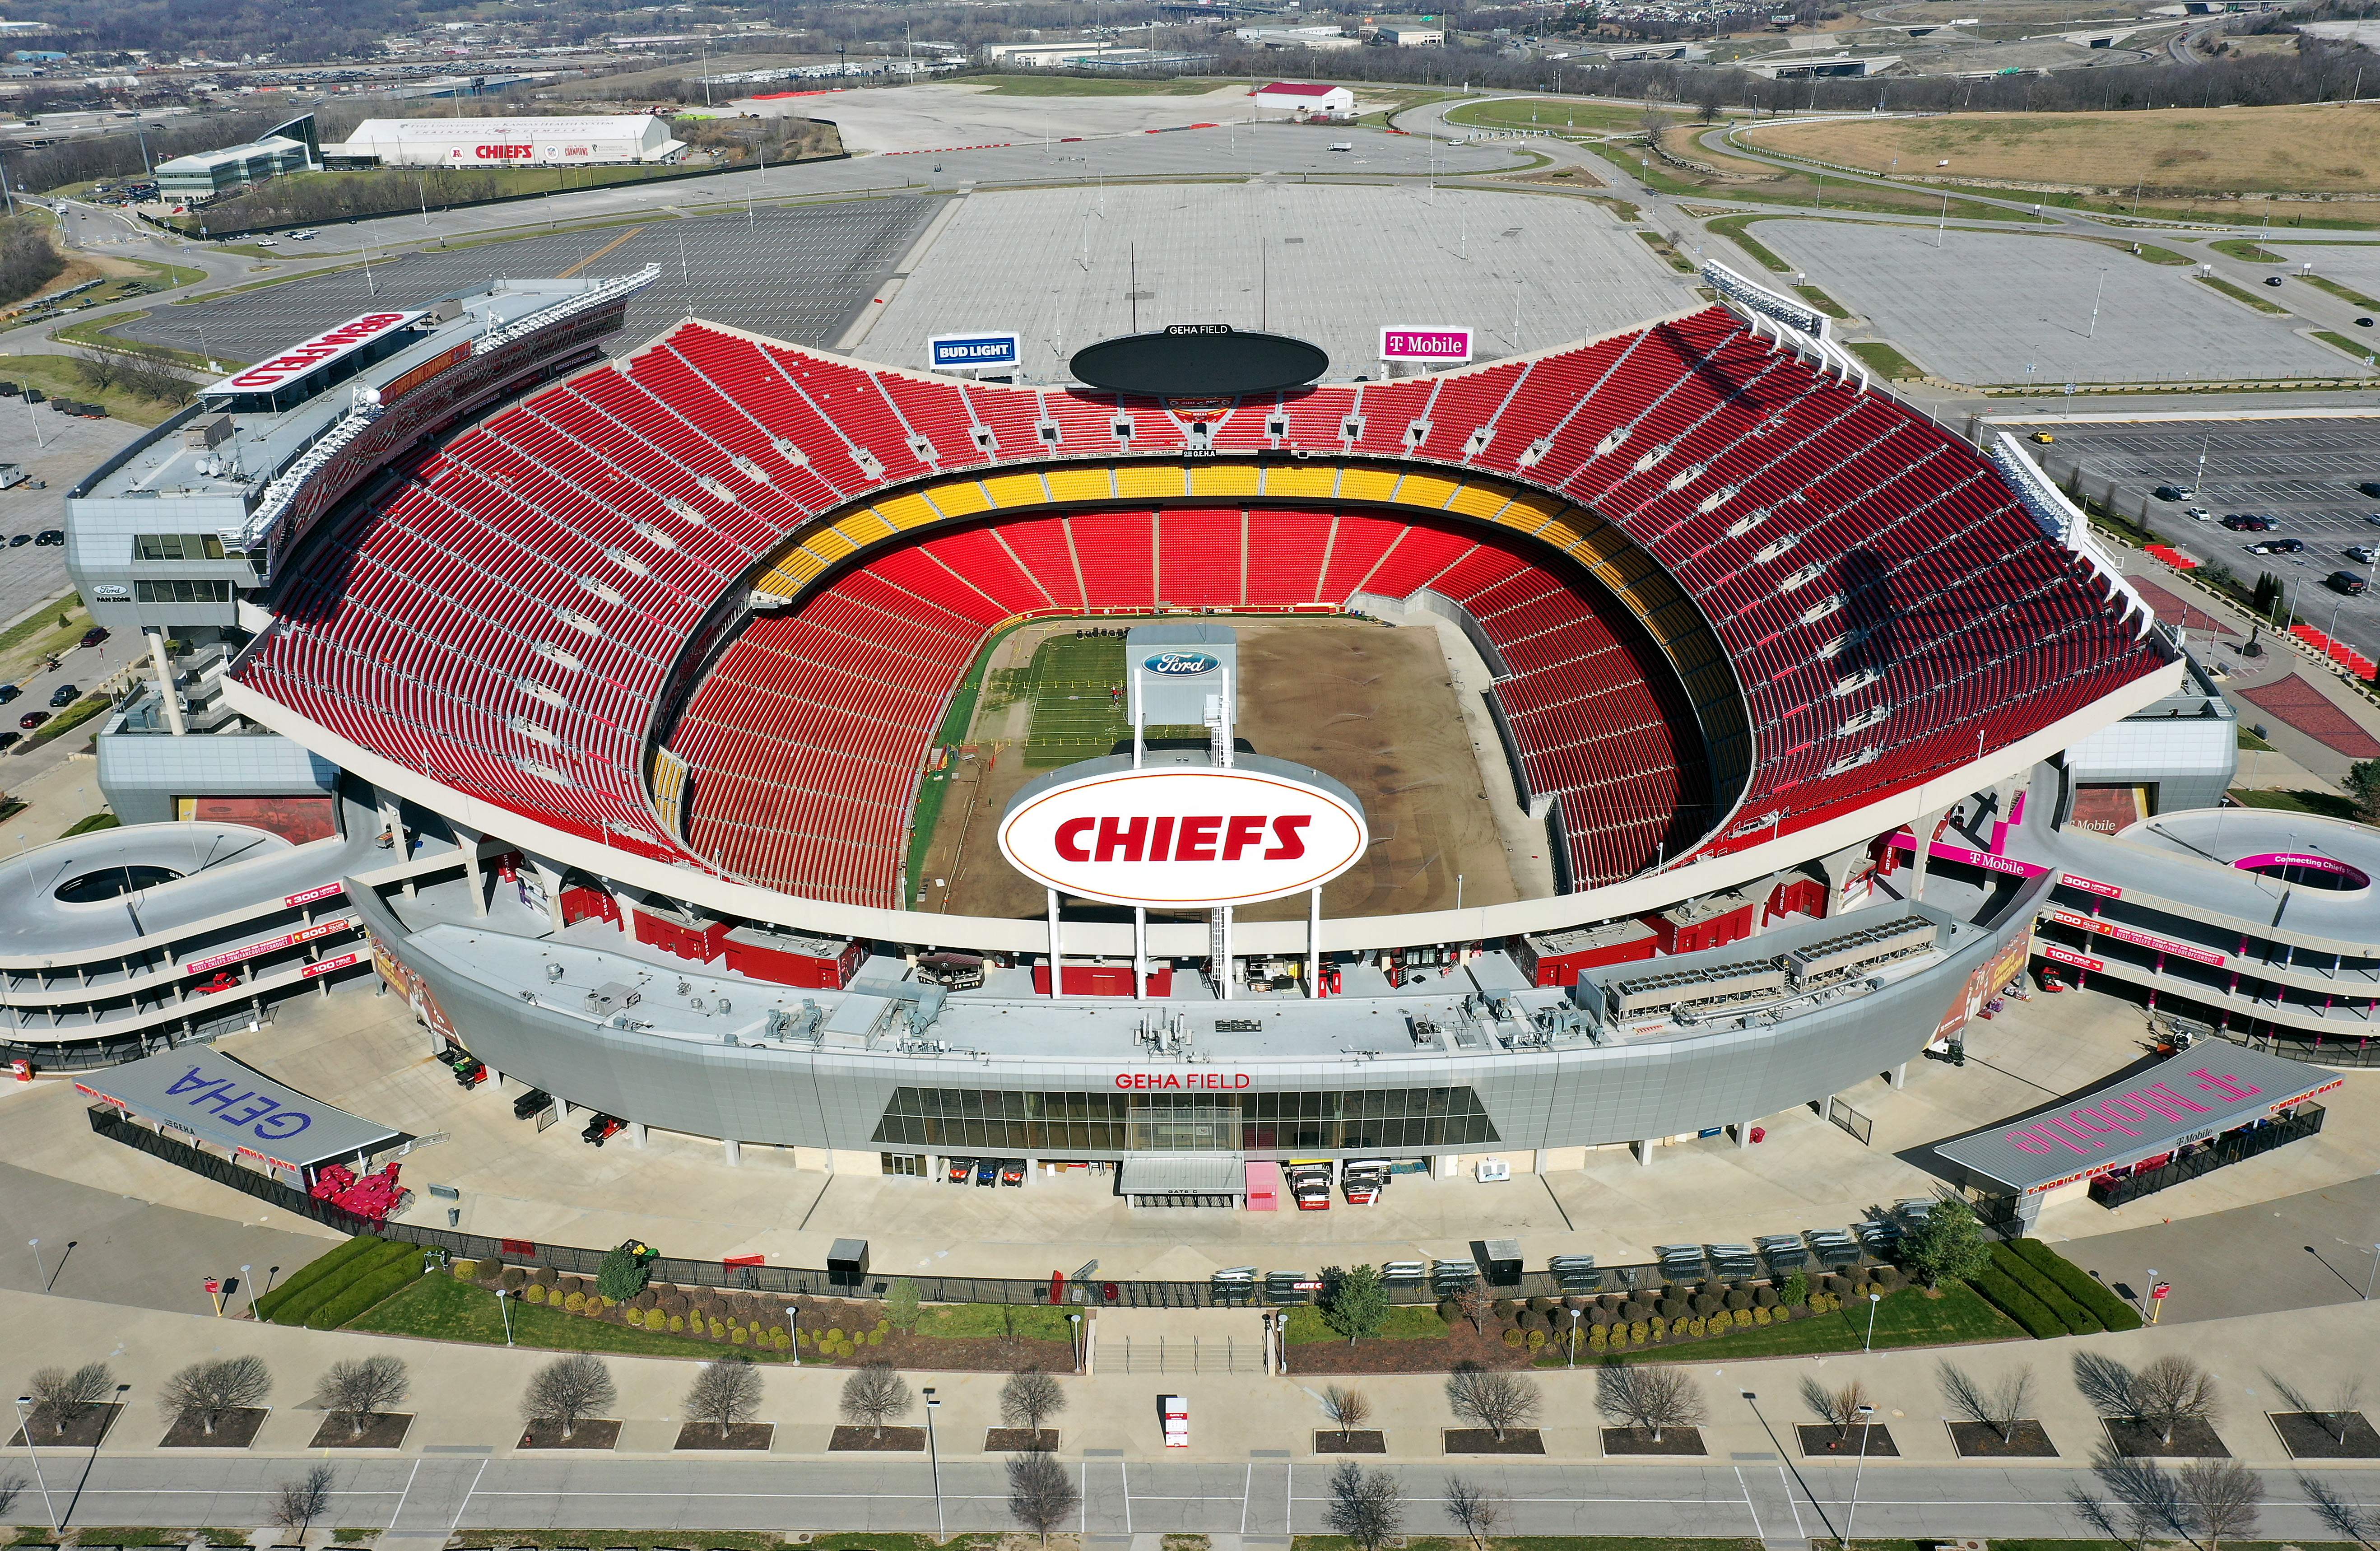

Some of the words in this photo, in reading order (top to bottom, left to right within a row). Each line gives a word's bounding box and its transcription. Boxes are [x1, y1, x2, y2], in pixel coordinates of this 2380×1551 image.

[475, 144, 533, 158] CHIEFS
[565, 148, 588, 156] CHAMPIONS
[307, 313, 404, 347] GEHA
[1170, 326, 1198, 334] GEHA
[1200, 326, 1227, 334] FIELD
[939, 346, 968, 358] BUD
[970, 345, 1009, 356] LIGHT
[1407, 336, 1462, 353] Mobile
[232, 348, 339, 387] FIELD
[1002, 615, 1023, 627] KINGDOM
[1157, 652, 1206, 672] Ford
[2078, 820, 2116, 831] Mobile
[1055, 815, 1311, 862] CHIEFS
[1982, 855, 2024, 874] Mobile
[2275, 856, 2321, 867] Connecting
[2324, 861, 2345, 873] Chiefs
[2064, 876, 2090, 888] 300
[294, 891, 319, 904] 300
[2054, 912, 2081, 925] 200
[302, 927, 327, 939] 200
[208, 940, 288, 969] CHIEFS.COM/FANCODEOFCONDUCT
[2050, 950, 2073, 961] 100
[2116, 932, 2131, 941] VISIT
[2132, 936, 2218, 964] CHIEFS.COM/FANCODEOFCONDUCT
[312, 962, 335, 973] 100
[1991, 954, 2025, 993] KINGDOM
[1994, 953, 2016, 978] CHIEFS
[377, 959, 408, 997] KINGDOM
[1116, 1073, 1181, 1089] GEHA
[1187, 1073, 1250, 1089] FIELD
[165, 1067, 311, 1140] GEHA
[2268, 1090, 2315, 1112] T-MOBILE
[2317, 1079, 2343, 1094] GATE
[2006, 1082, 2214, 1155] Mobile
[2185, 1128, 2213, 1145] Mobile
[269, 1156, 297, 1172] GATE
[2026, 1172, 2082, 1195] T-MOBILE
[2085, 1162, 2116, 1177] GATE
